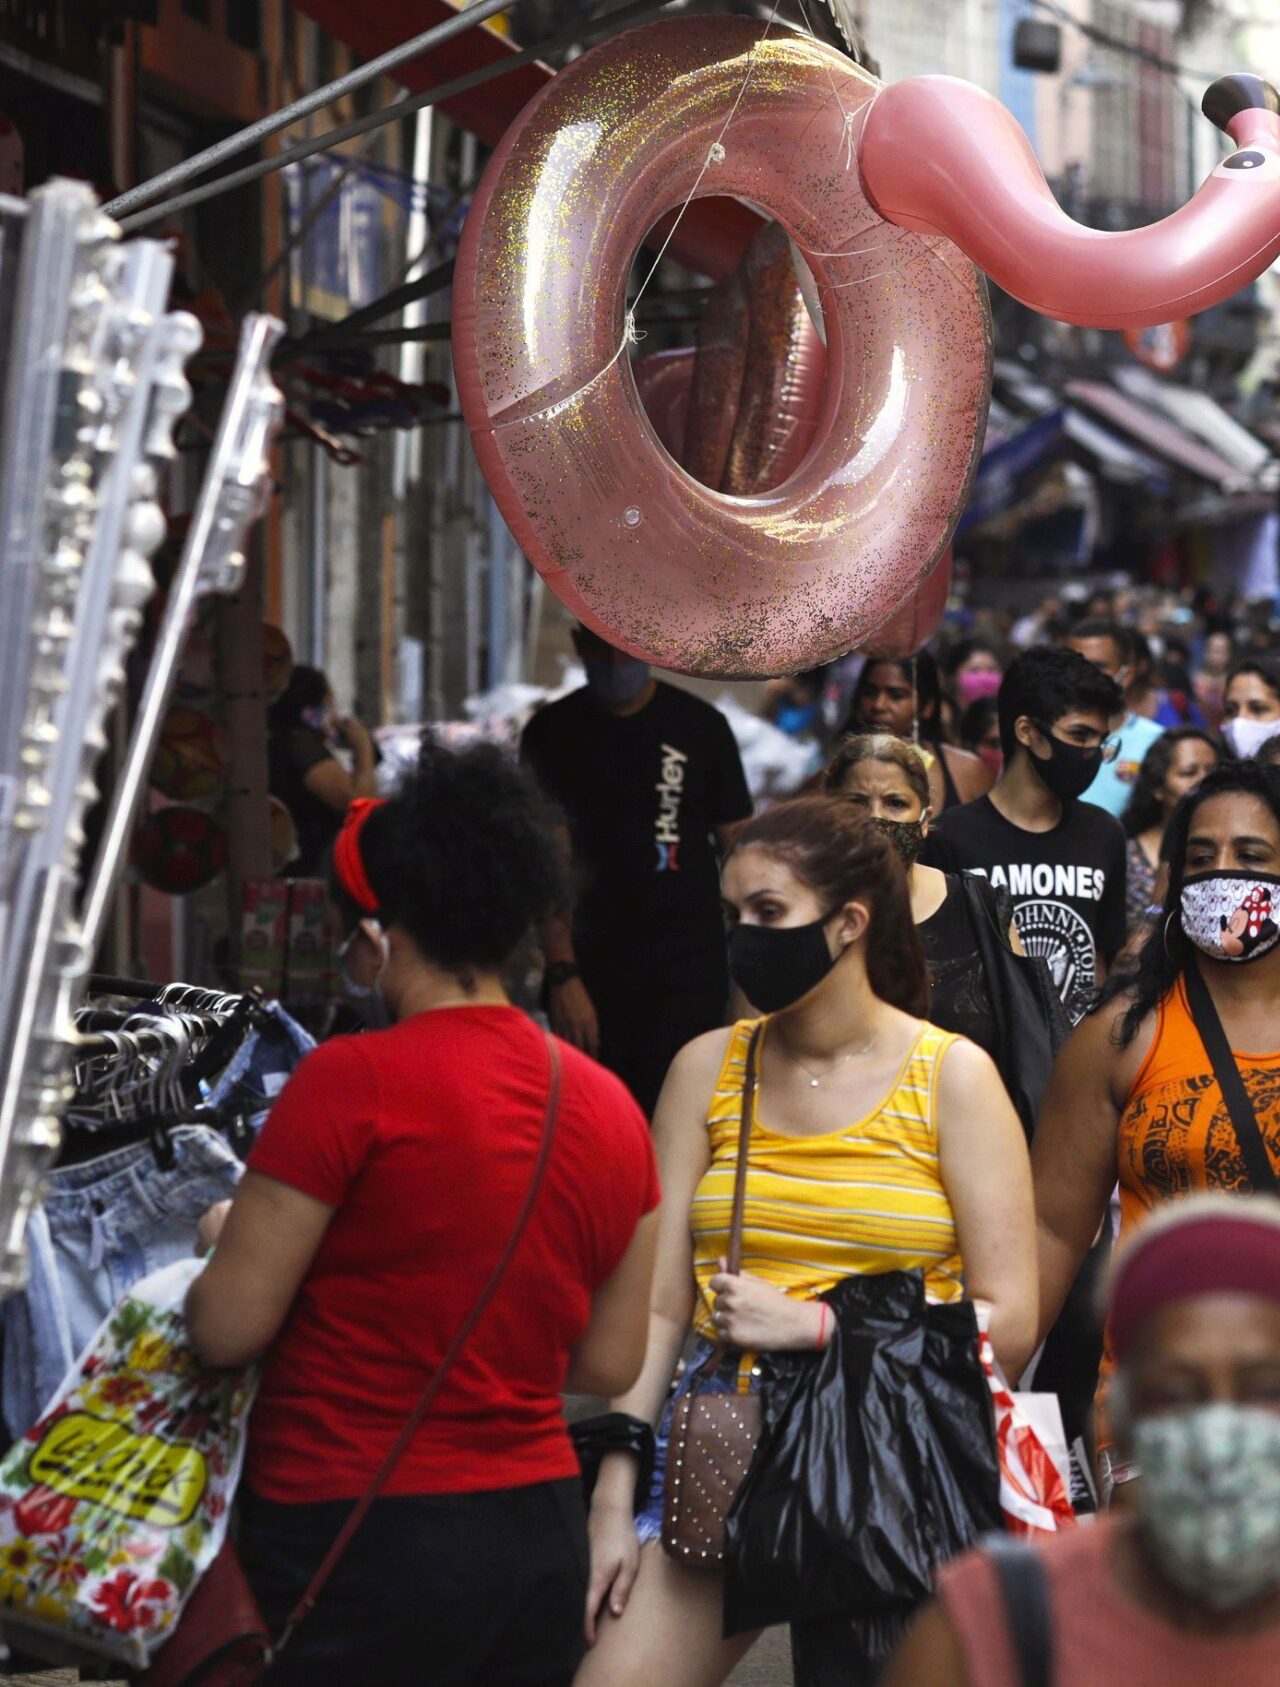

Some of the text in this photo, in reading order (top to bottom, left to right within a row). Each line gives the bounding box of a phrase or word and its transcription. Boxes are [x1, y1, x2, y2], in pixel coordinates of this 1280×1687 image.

[655, 743, 688, 842] Hurley
[1013, 904, 1084, 936] OHNNY
[1076, 943, 1097, 993] JOE
